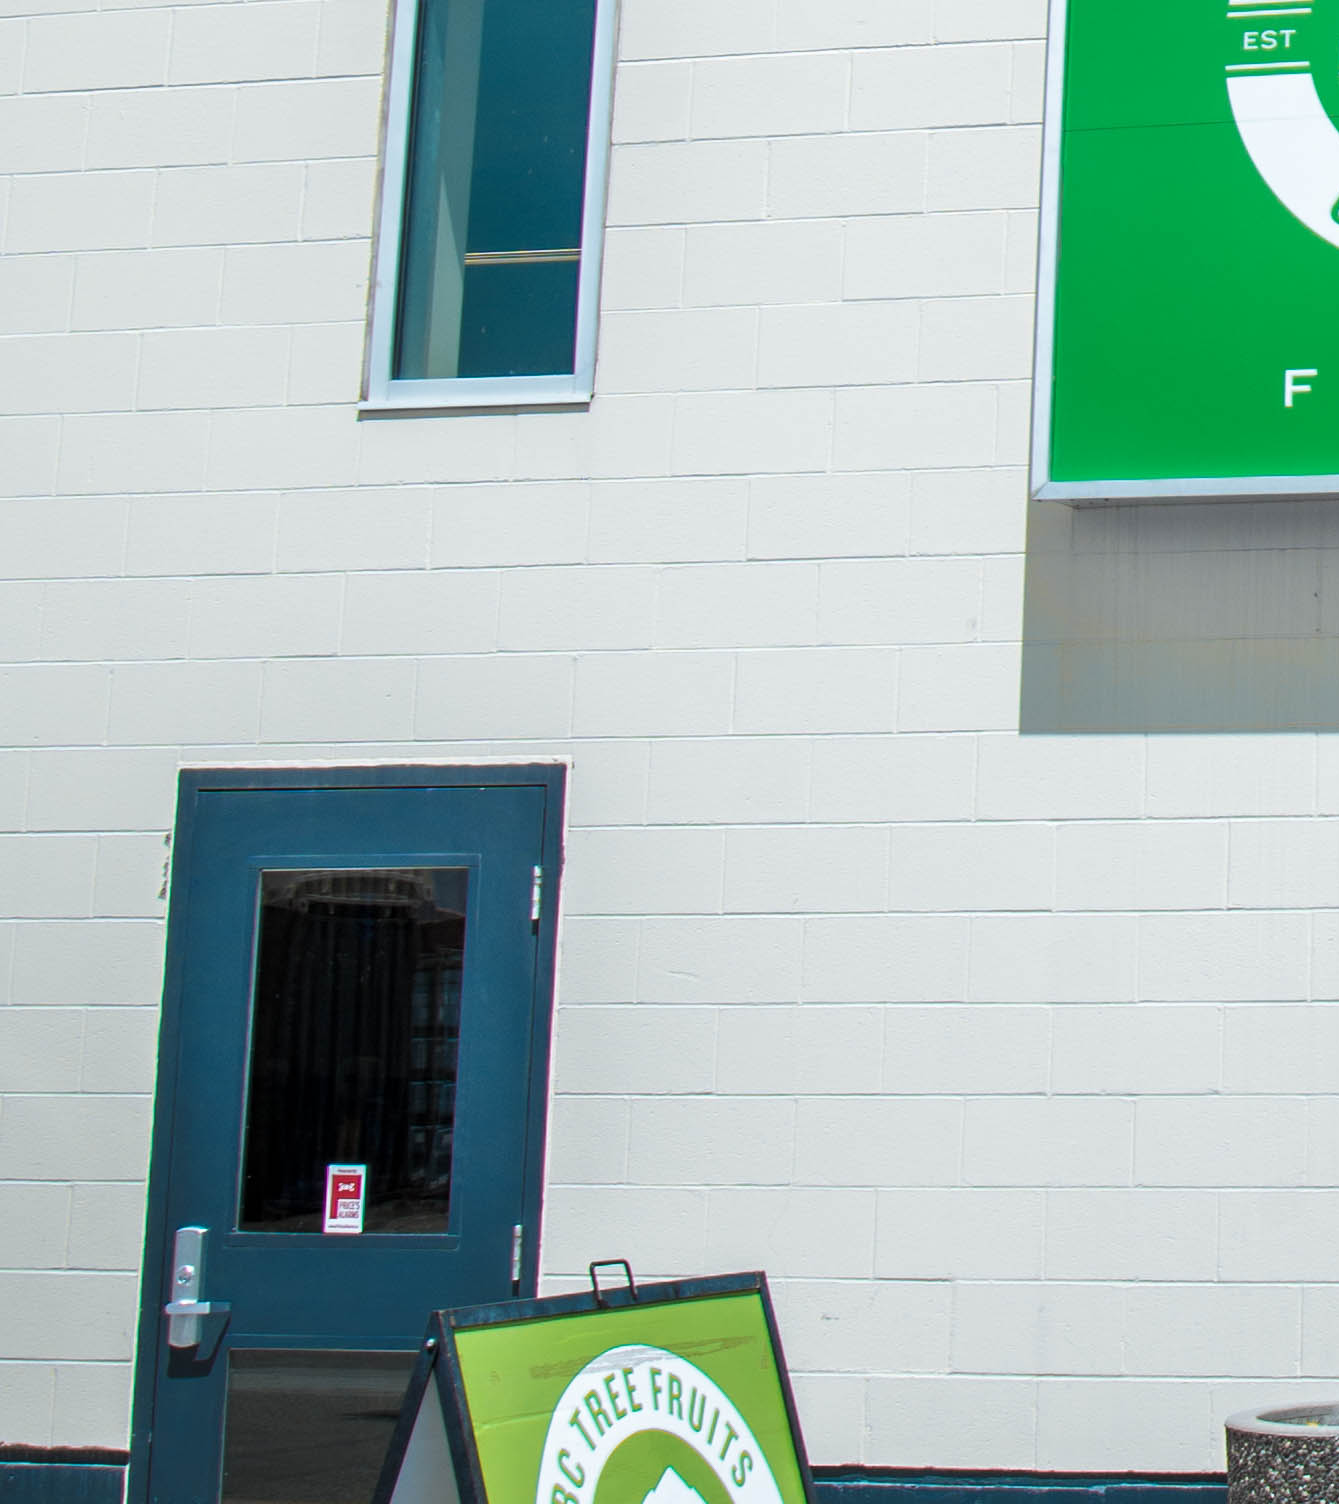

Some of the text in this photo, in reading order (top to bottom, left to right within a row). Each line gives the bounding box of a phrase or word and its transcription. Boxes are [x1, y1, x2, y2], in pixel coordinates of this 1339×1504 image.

[1242, 29, 1297, 51] EST
[568, 1366, 643, 1452] TREE
[648, 1367, 754, 1489] FRUITS
